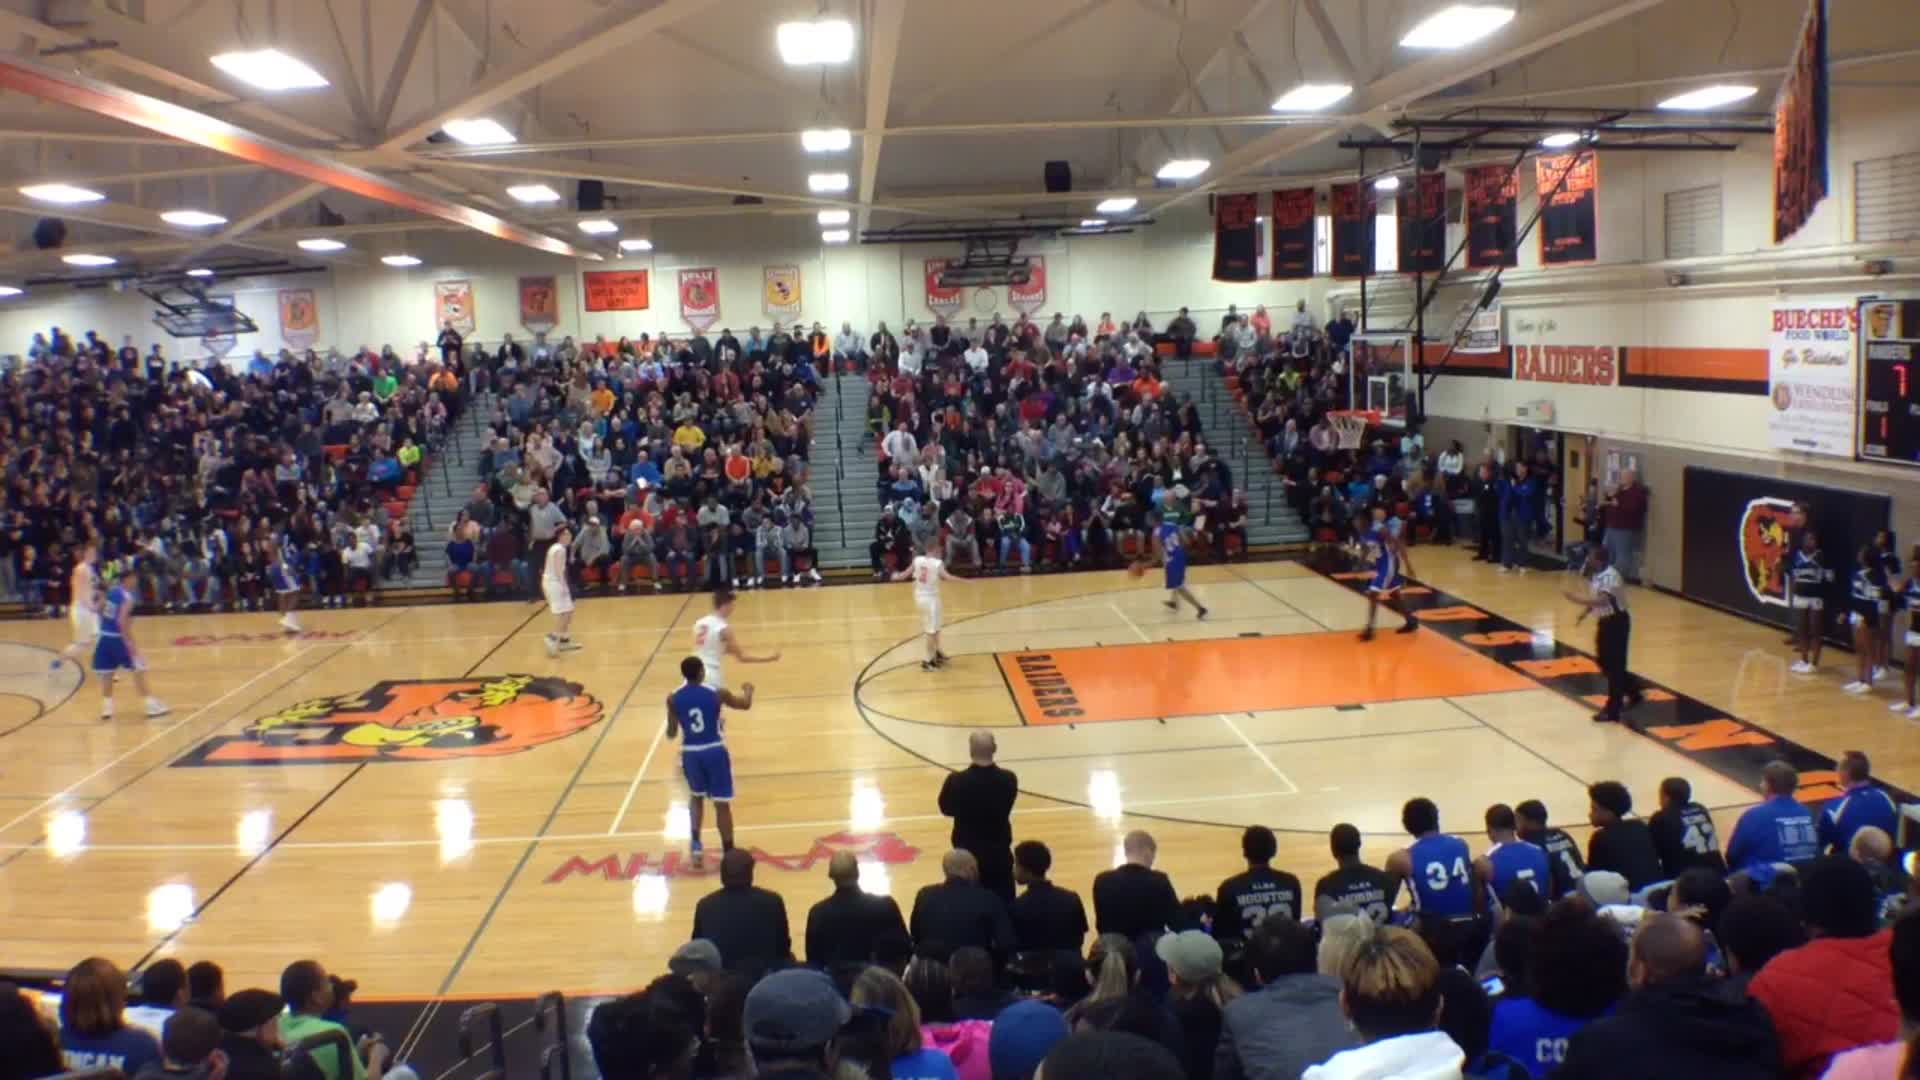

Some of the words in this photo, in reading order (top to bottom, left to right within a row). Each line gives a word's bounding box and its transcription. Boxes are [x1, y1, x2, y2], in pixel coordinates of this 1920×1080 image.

[1515, 345, 1615, 386] RAIDERS
[1016, 655, 1086, 718] RAIDERS
[688, 707, 705, 733] 3
[1425, 856, 1470, 891] 34
